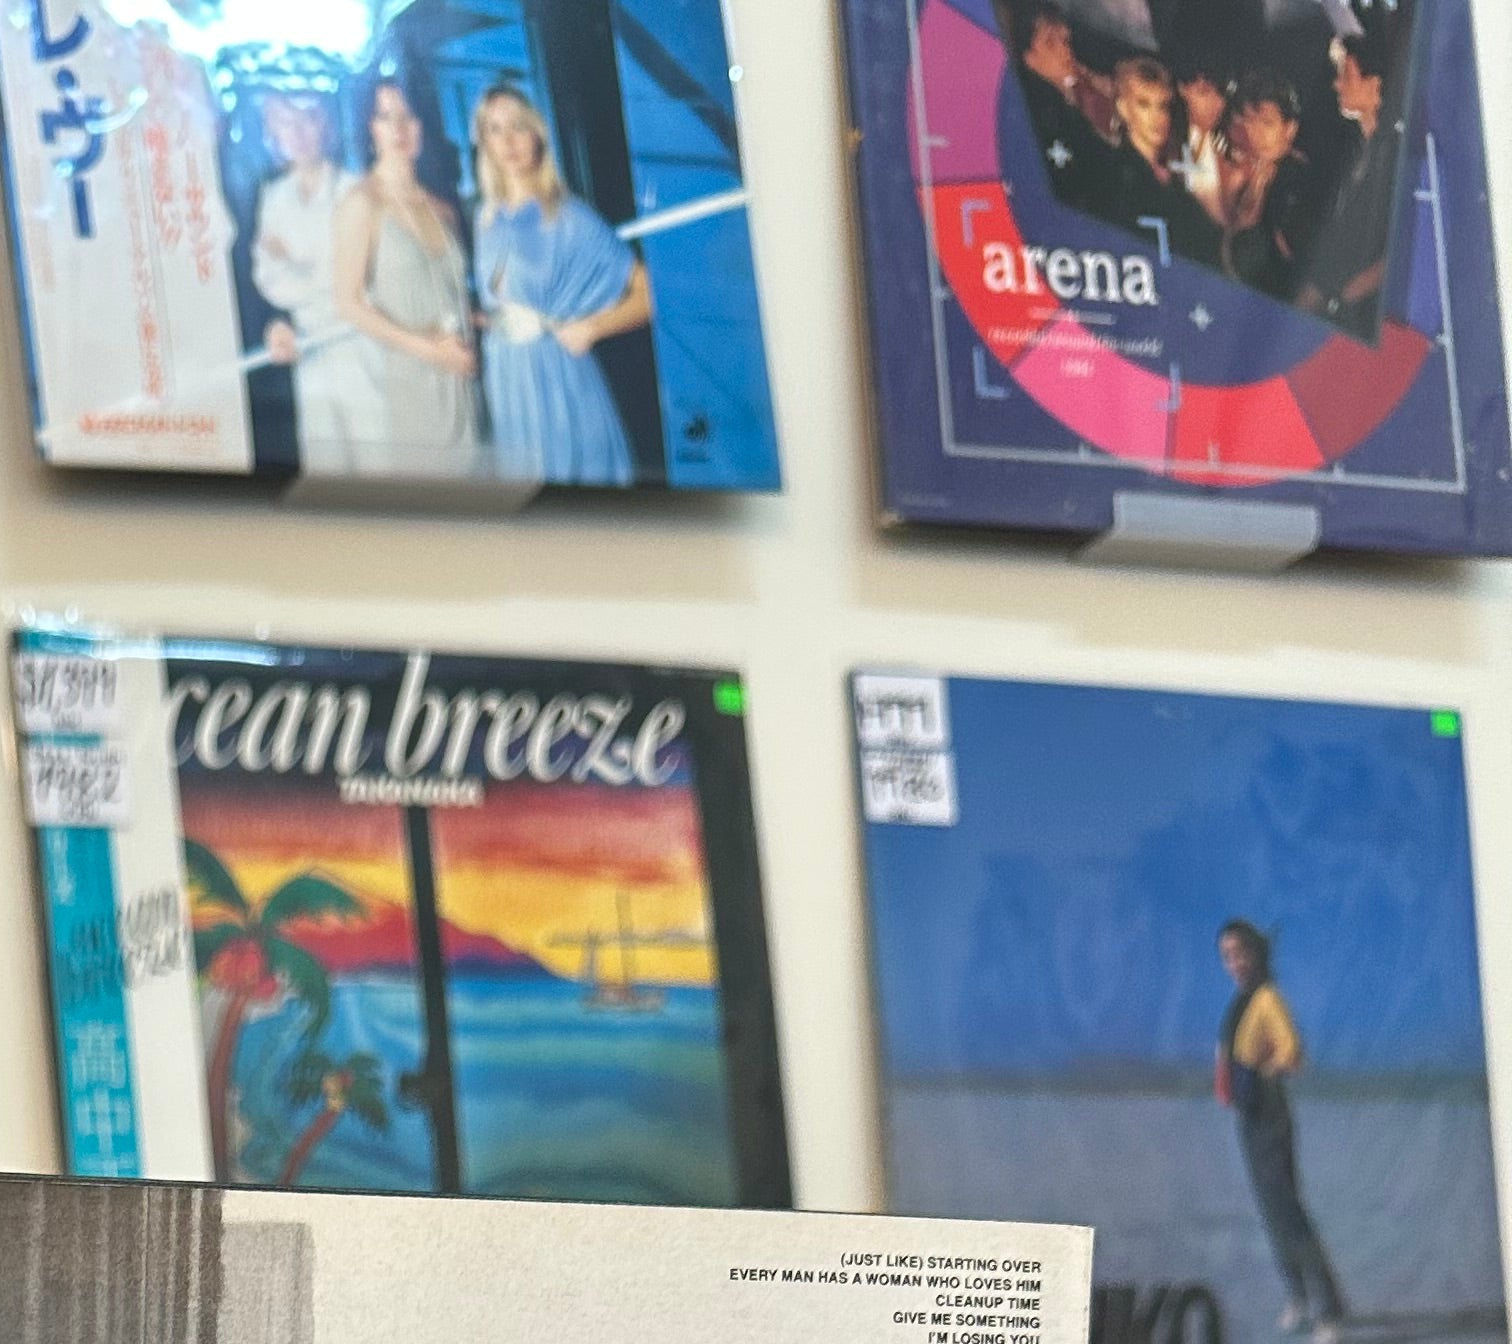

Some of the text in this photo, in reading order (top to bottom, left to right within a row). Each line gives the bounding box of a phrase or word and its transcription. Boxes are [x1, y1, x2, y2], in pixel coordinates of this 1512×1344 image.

[983, 242, 1159, 306] arena
[167, 651, 686, 787] cean breeze
[840, 1252, 1042, 1273] (JUST LIKE) STARTING OVER
[729, 1268, 1041, 1293] EVERY MAN HAS A WOMAN WHO LOVES HIM
[935, 1294, 1041, 1311] CLEANUP TIME
[893, 1311, 1041, 1329] GIVE ME SOMETHING
[928, 1331, 949, 1344] I'M
